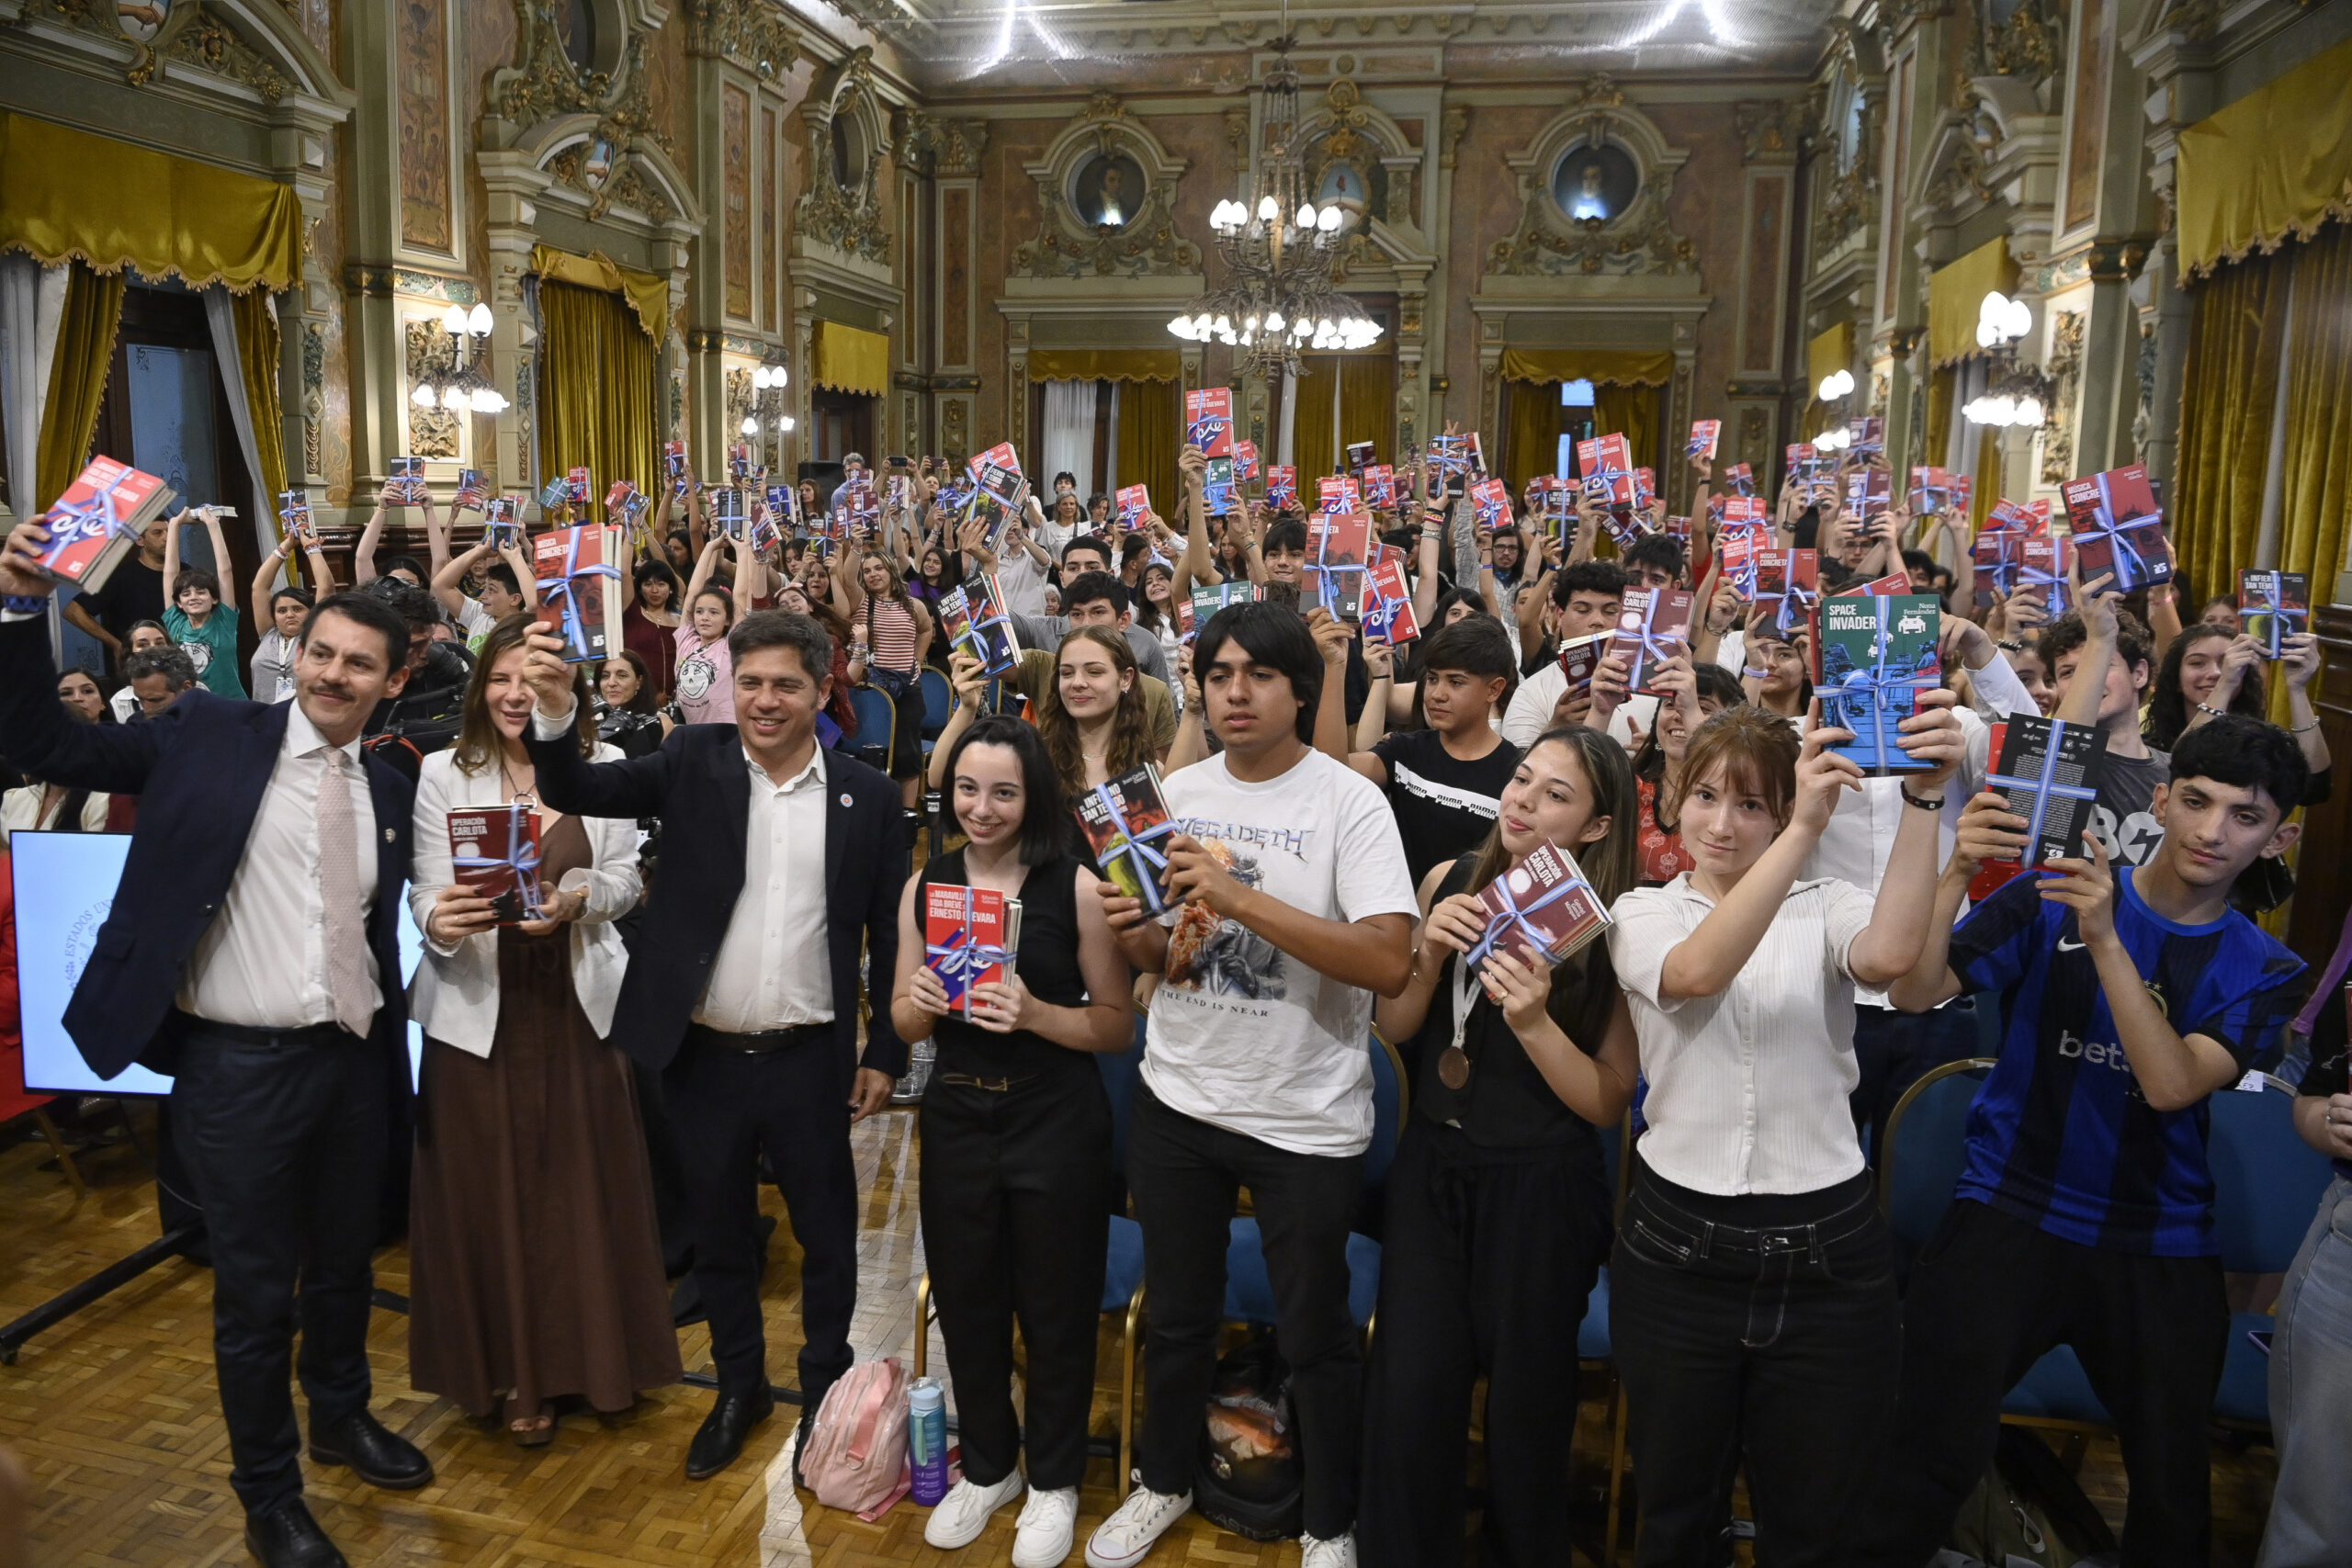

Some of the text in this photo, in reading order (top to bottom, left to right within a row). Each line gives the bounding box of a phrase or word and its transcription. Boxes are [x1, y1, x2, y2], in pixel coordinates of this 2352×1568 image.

[2067, 482, 2092, 494] MÚSICA
[2069, 489, 2100, 503] CONCRE
[941, 588, 965, 606] INFIERO
[1194, 596, 1222, 607] INVADERS
[1623, 598, 1649, 608] CARLOT
[1829, 604, 1857, 615] SPACE
[1829, 616, 1878, 630] INVADER
[1566, 651, 1591, 663] CARLOTA
[1084, 784, 1121, 808] INFINO
[1096, 794, 1125, 816] TEDO
[452, 826, 488, 836] CARLOTA
[1538, 845, 1563, 880] OPERACIÓN
[1529, 852, 1555, 888] CARLOTA
[930, 899, 962, 909] VIDA BREVE
[930, 908, 962, 919] ERNESTO
[64, 909, 93, 958] ESTADOS
[1160, 989, 1269, 1018] THE END IS NEAR
